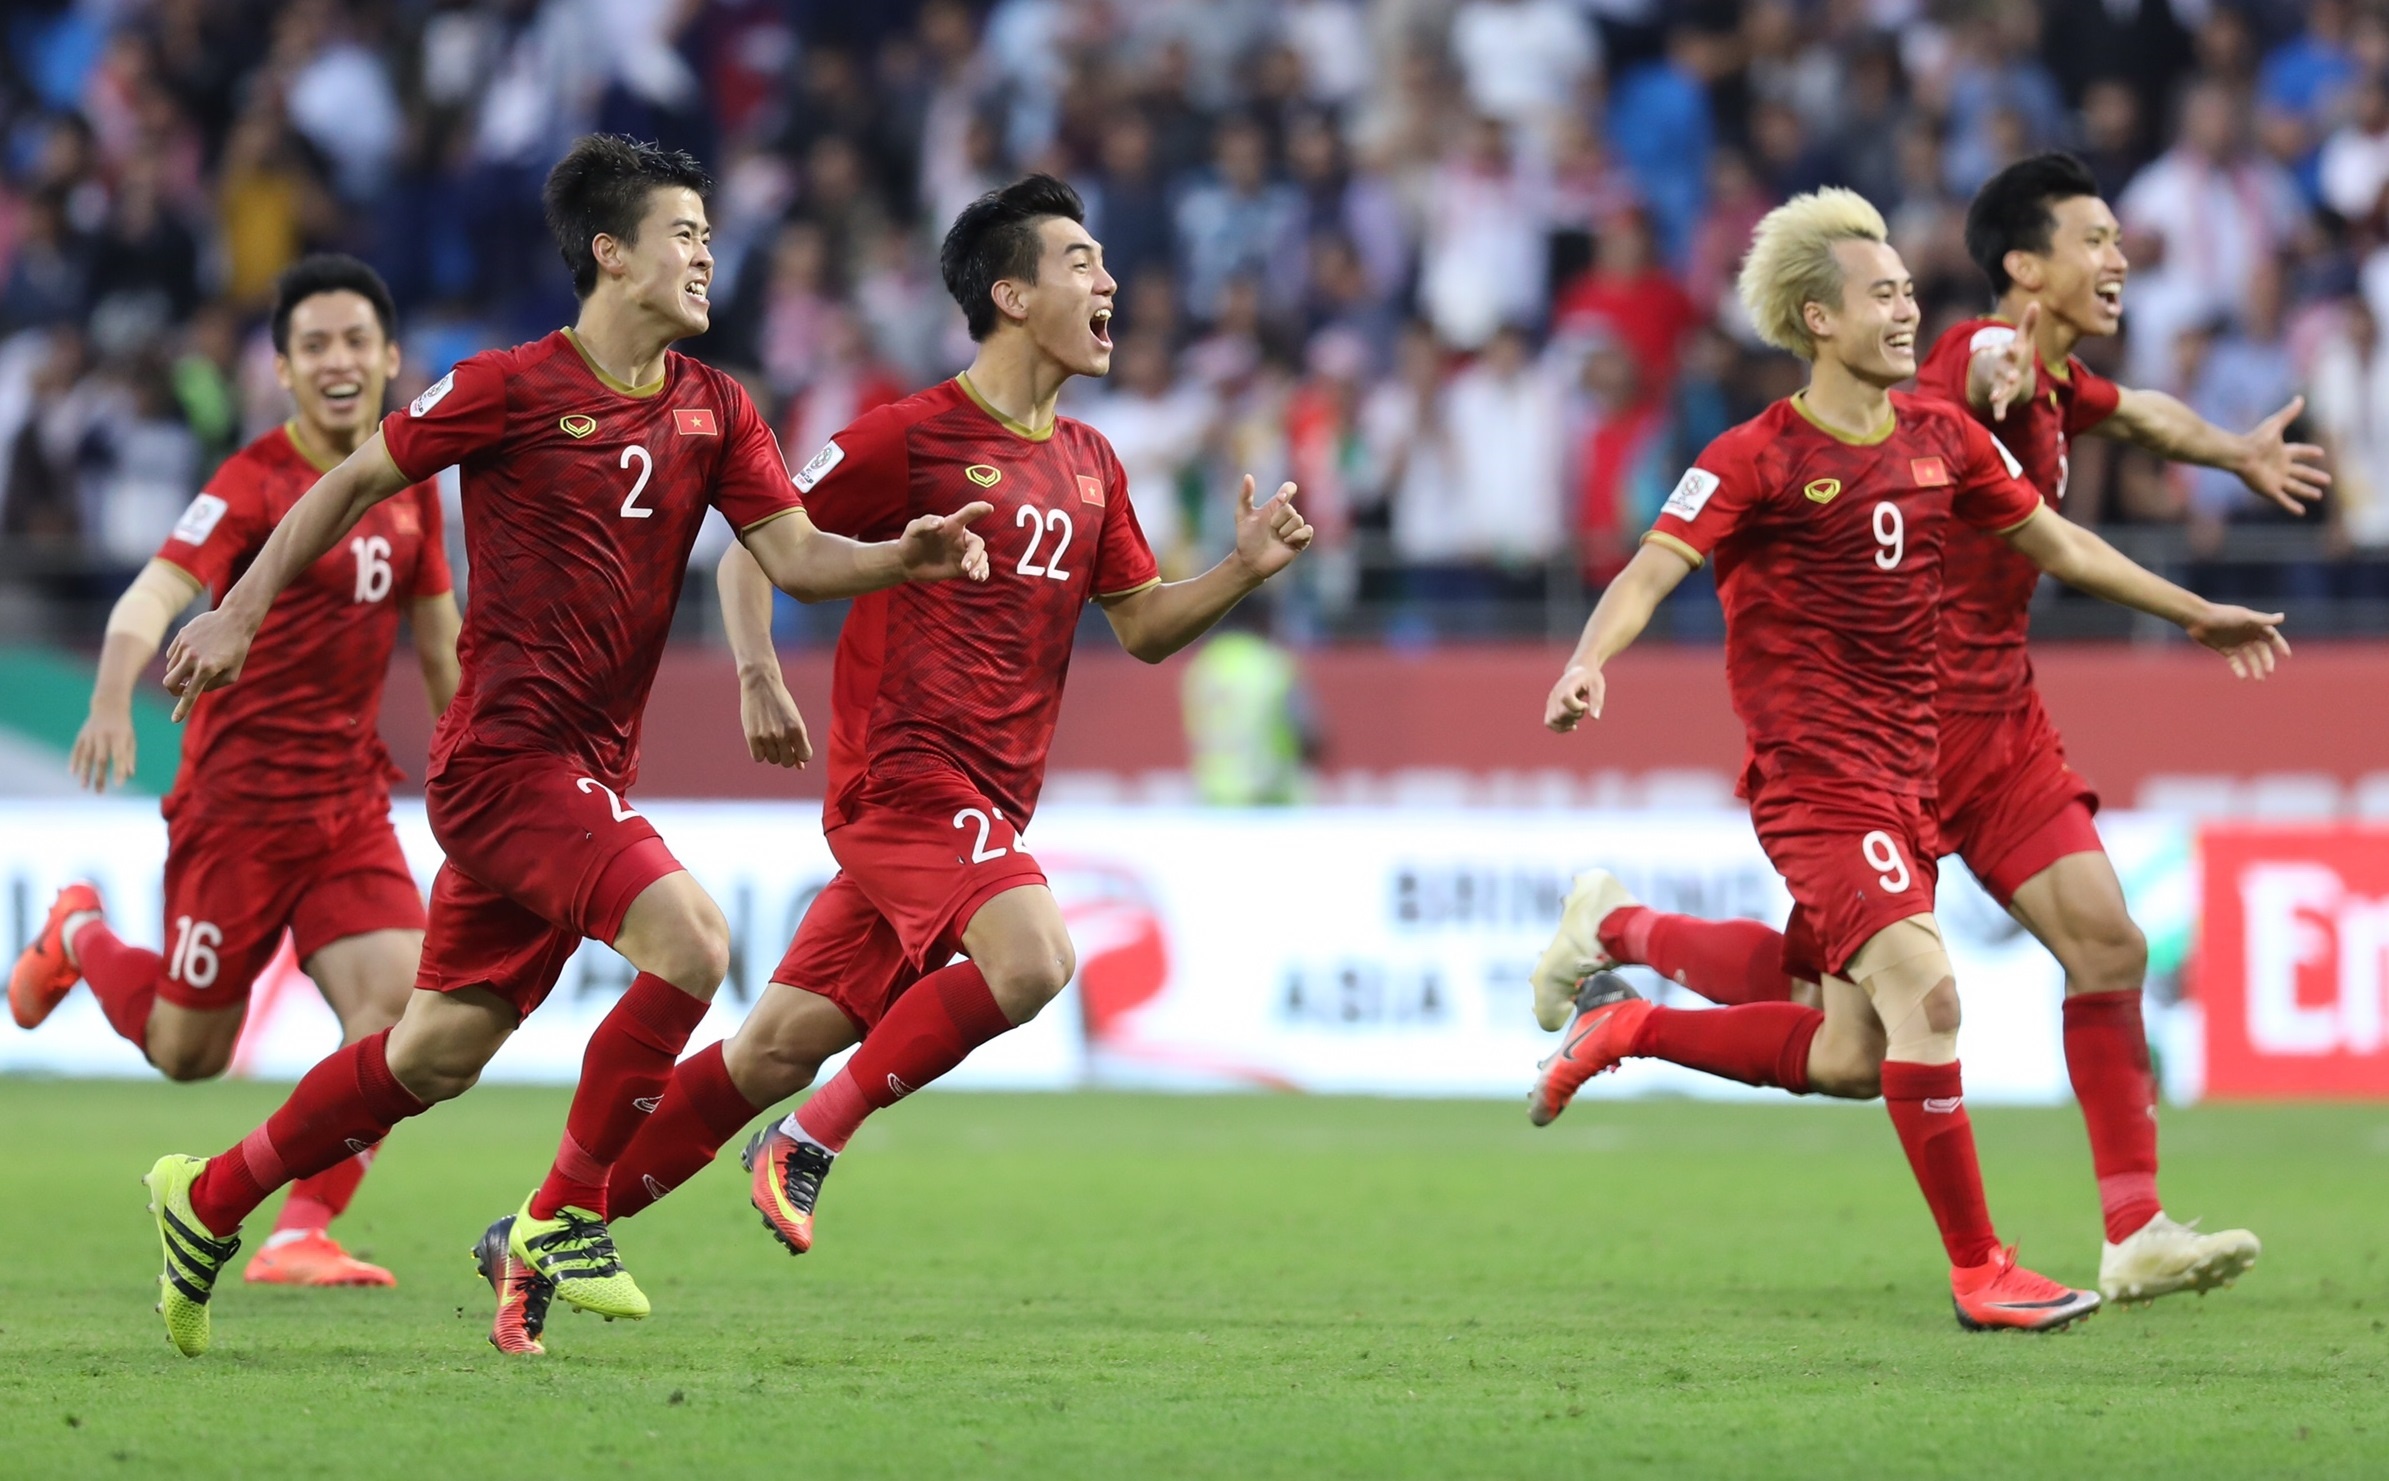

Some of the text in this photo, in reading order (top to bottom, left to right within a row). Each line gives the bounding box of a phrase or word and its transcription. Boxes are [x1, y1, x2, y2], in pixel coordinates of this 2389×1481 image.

[619, 444, 654, 519] 2
[349, 535, 394, 603] 16
[1015, 500, 1073, 582] 22
[1872, 500, 1904, 571] 9
[576, 777, 642, 823] 2
[1862, 830, 1911, 894] 9
[169, 915, 223, 988] 16
